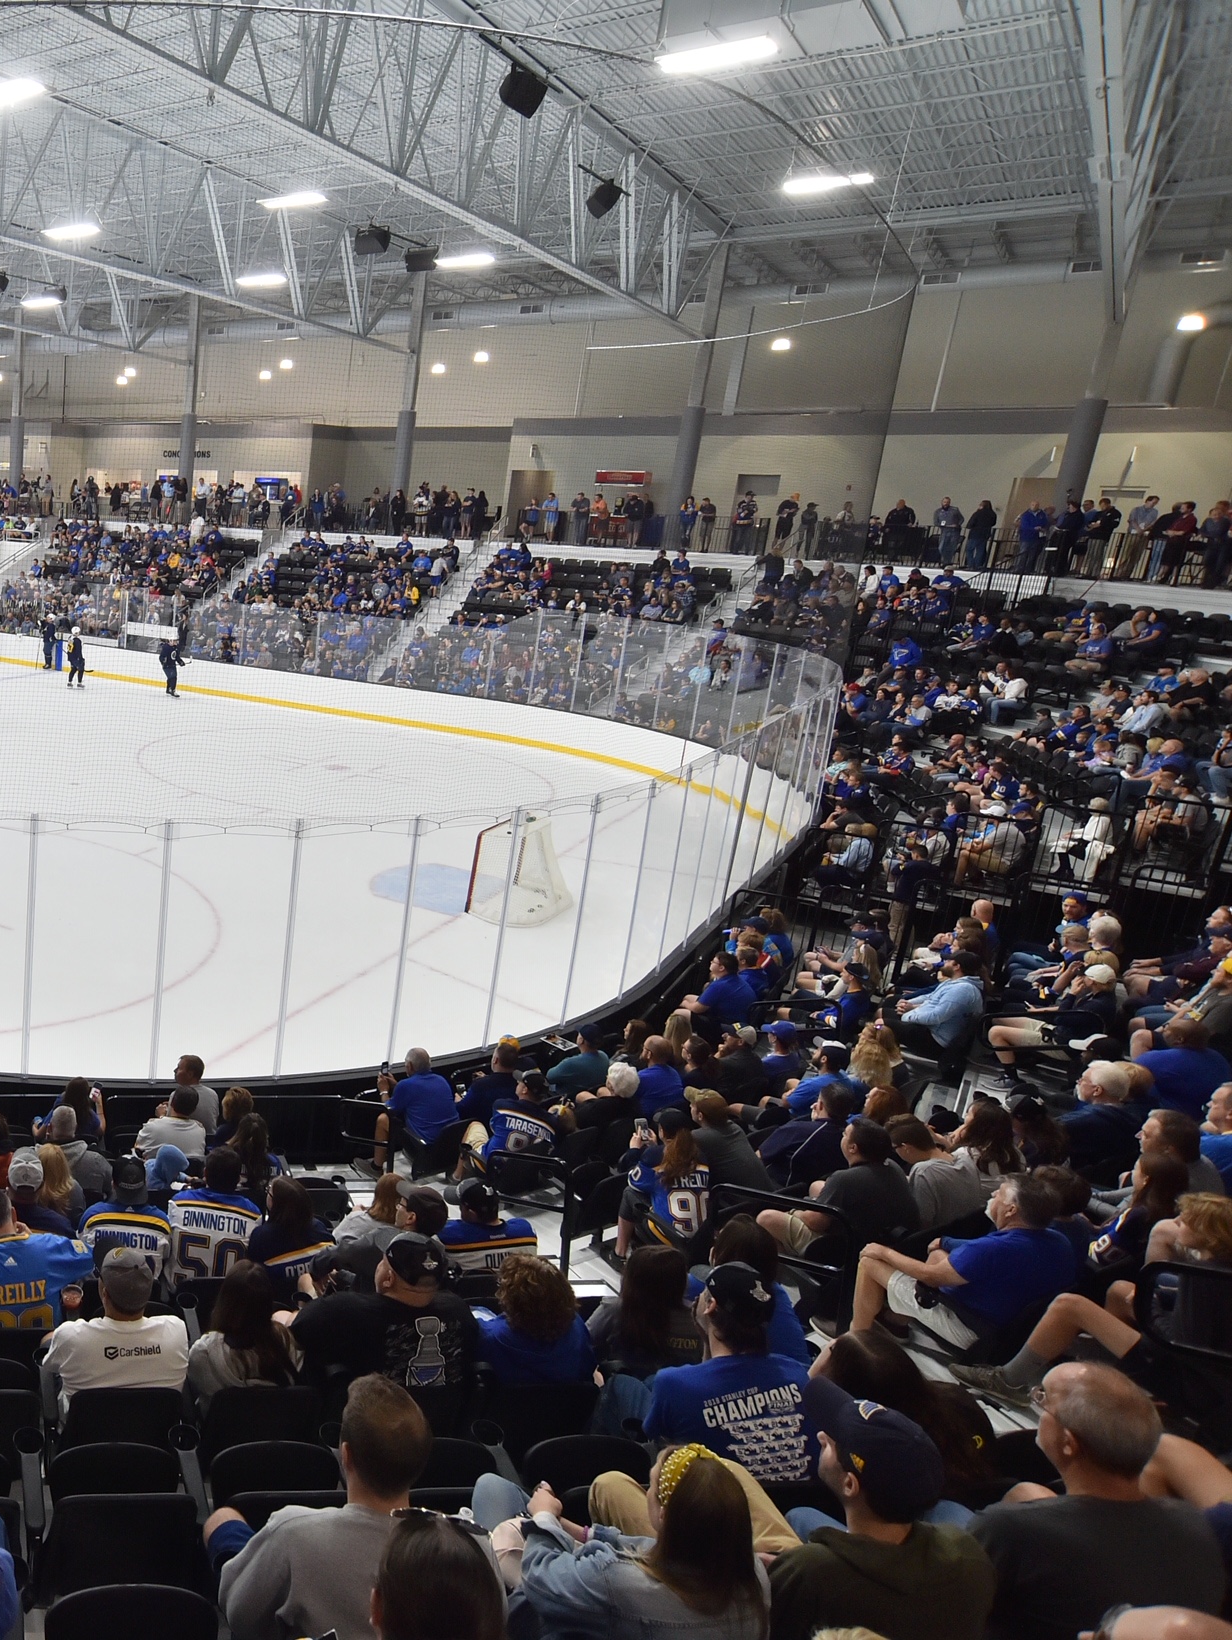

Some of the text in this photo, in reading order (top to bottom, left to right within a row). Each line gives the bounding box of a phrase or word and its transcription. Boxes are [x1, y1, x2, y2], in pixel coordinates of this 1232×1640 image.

[505, 1116, 551, 1143] TARASENKO
[182, 1209, 248, 1238] BINNINGTON
[173, 1231, 249, 1286] 50
[119, 1344, 162, 1358] CarShield
[703, 1383, 803, 1428] CHAMPIONS
[721, 1390, 746, 1402] STANLEY
[747, 1386, 759, 1396] CUP
